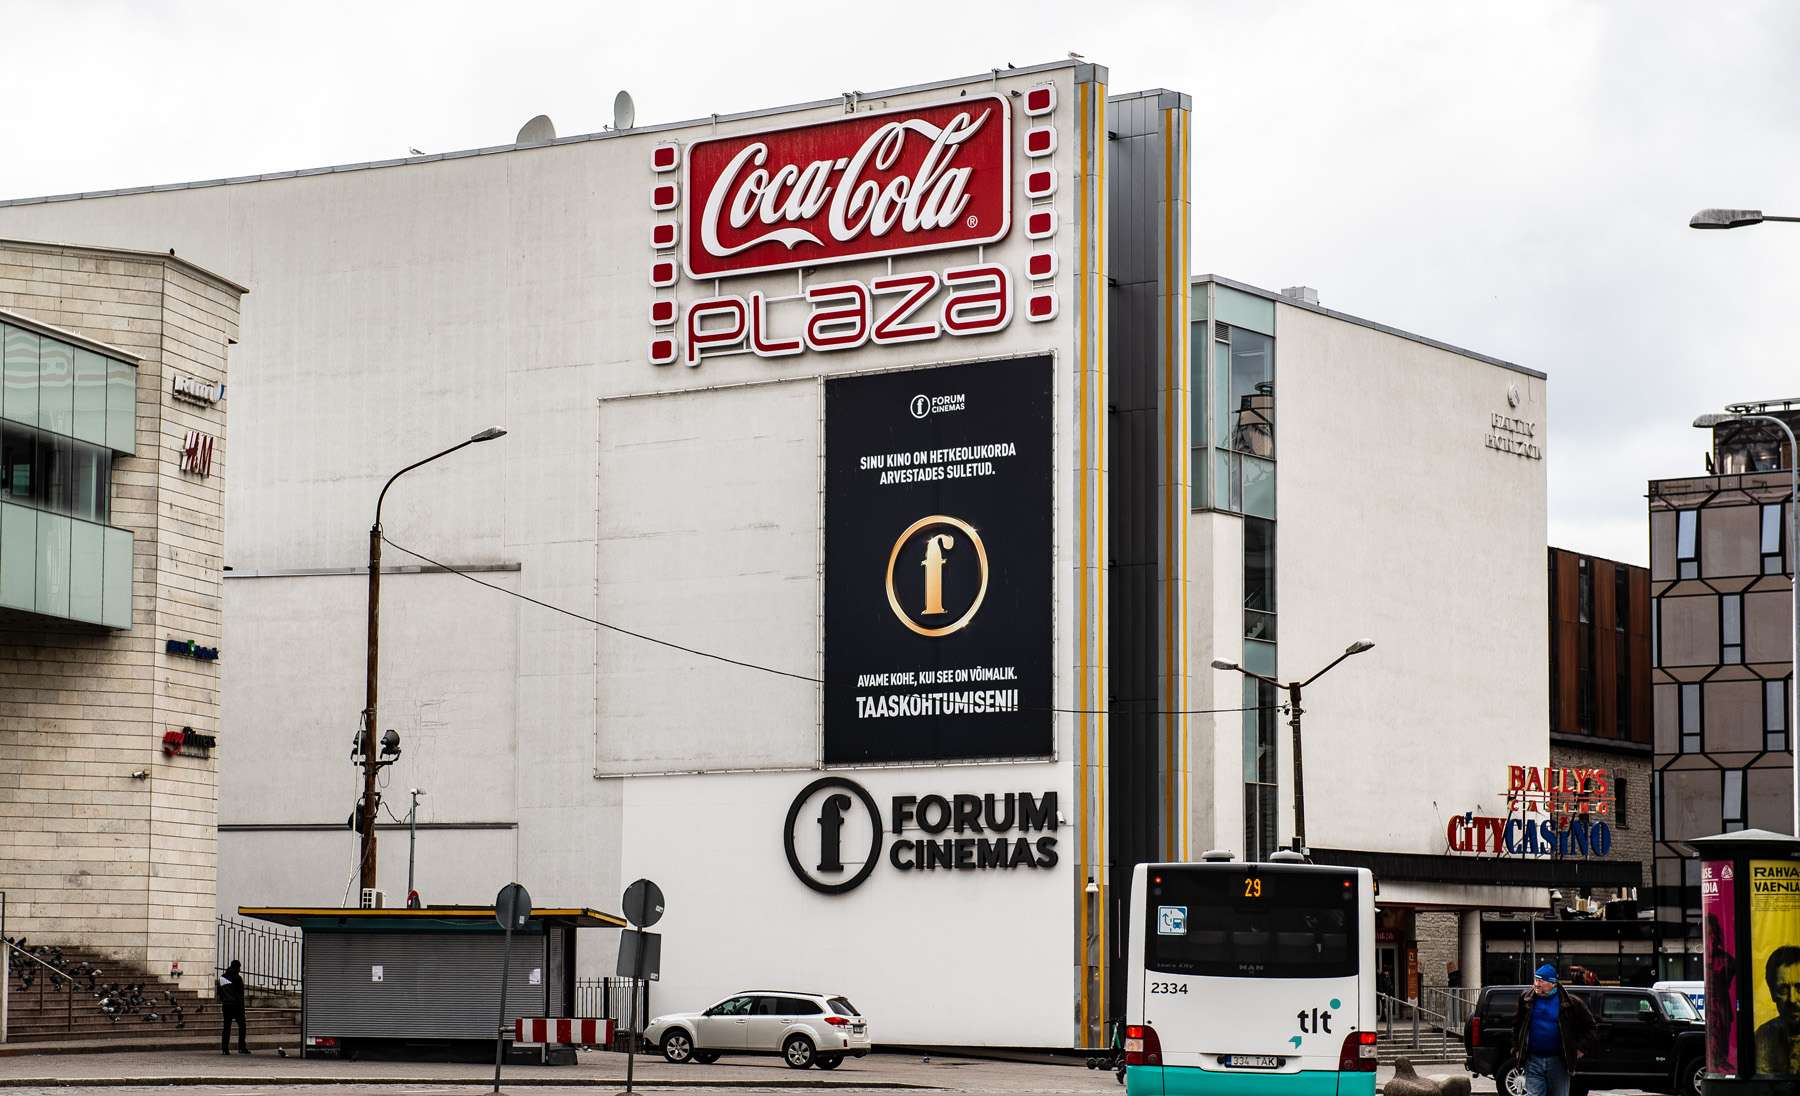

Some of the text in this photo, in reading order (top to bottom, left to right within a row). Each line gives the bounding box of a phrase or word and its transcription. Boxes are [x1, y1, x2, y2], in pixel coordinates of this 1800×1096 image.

[702, 108, 992, 257] Coca-Cola
[931, 403, 965, 414] CINEMAS
[932, 393, 965, 406] FORUM
[860, 442, 1017, 470] SINU KINO ON HETKEOLUKORDA
[879, 462, 996, 485] ARVESTADES SULETUD.
[857, 665, 1018, 688] AVAME KOHE, KUI SEE ON VÕIMALIK.
[1507, 765, 1609, 796] BALLY'S
[891, 791, 1059, 834] FORUM
[889, 836, 1059, 871] CINEMAS
[1244, 878, 1262, 897] 29
[1151, 982, 1189, 995] 2334
[1297, 1008, 1332, 1034] tlt
[1233, 1055, 1275, 1066] 334 TAK
